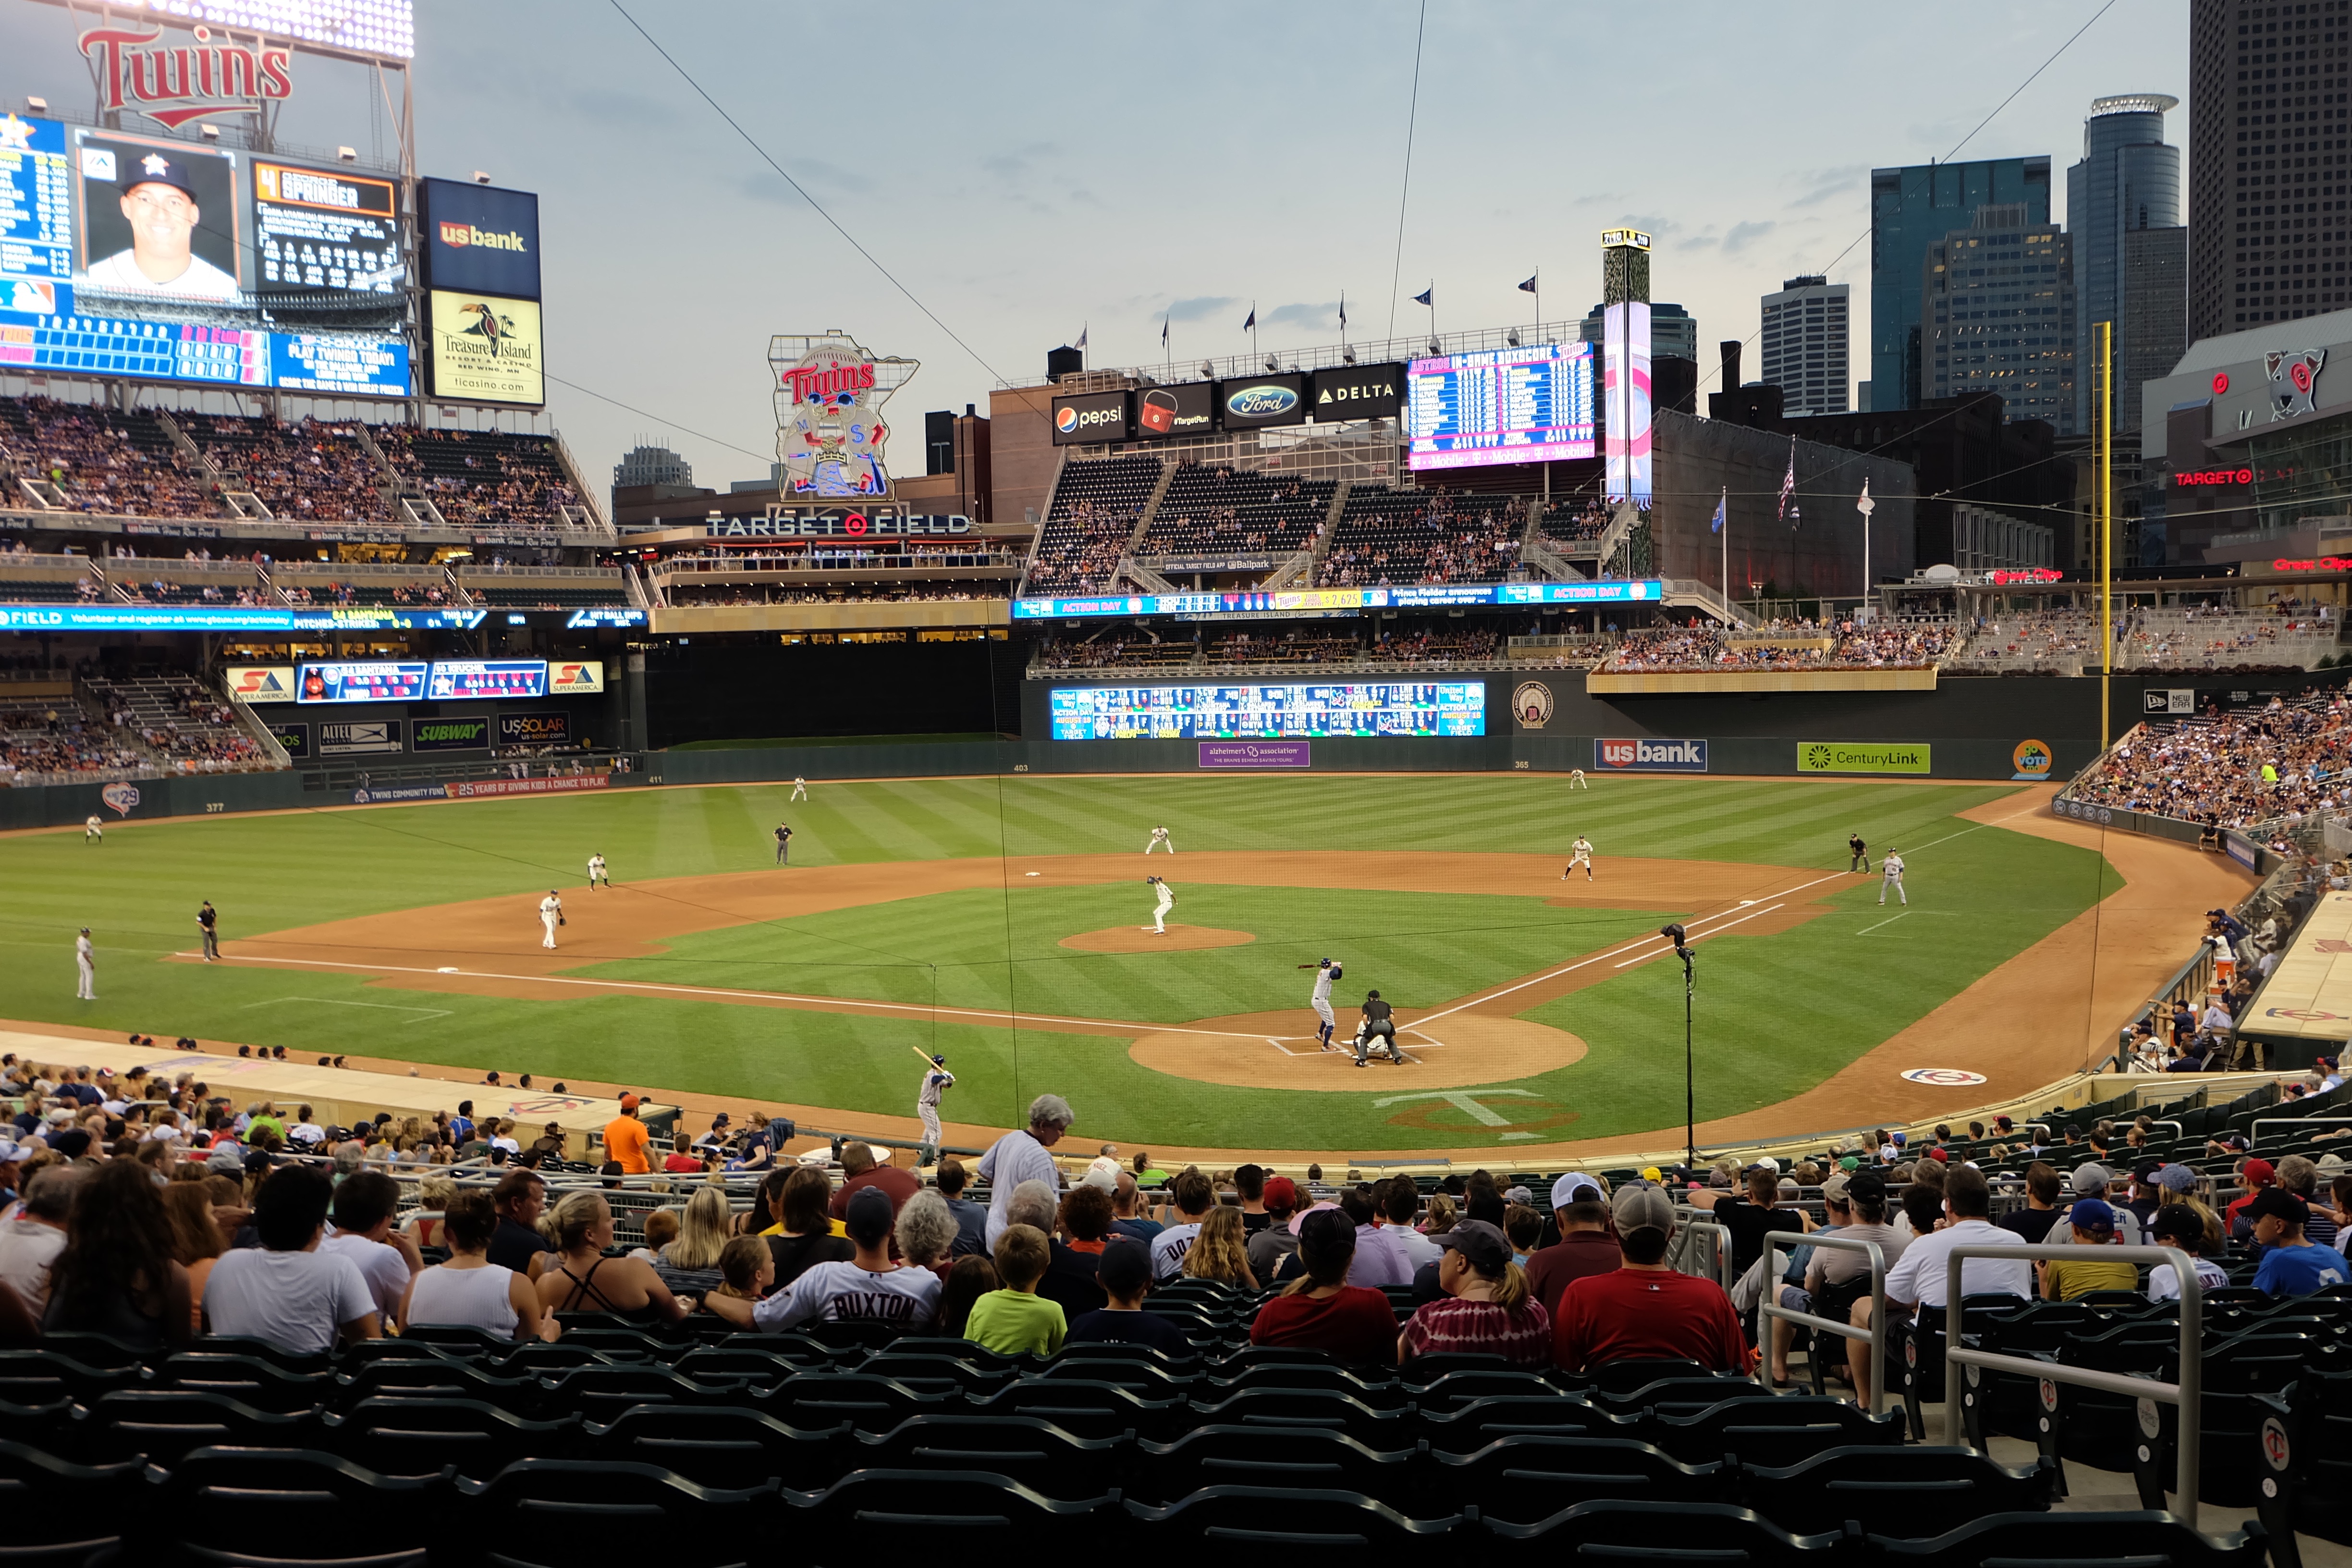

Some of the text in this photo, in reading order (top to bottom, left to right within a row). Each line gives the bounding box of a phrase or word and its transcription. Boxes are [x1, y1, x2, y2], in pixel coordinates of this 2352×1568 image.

[78, 24, 292, 113] Twins
[261, 169, 277, 196] 4
[282, 181, 358, 208] SPRINGER
[211, 328, 221, 343] E
[443, 335, 531, 359] Treasure Island
[288, 344, 395, 367] PLAY TWINGO TODAY!
[1411, 357, 1450, 372] ASTROS
[1557, 342, 1587, 359] Twins
[455, 378, 524, 392] ticasino.com
[783, 361, 874, 405] Twins
[1337, 383, 1393, 402] DELTA
[1241, 391, 1283, 413] Ford
[1080, 406, 1122, 428] pepsi
[1174, 415, 1209, 426] #TargetRun
[797, 419, 808, 431] M
[851, 425, 865, 443] S
[2176, 471, 2235, 486] TARGET
[706, 515, 969, 536] TARGET FIELD
[346, 533, 365, 542] Home
[367, 534, 381, 543] Run
[383, 535, 401, 544] Porch
[507, 537, 525, 546] Home
[527, 538, 539, 547] Run
[540, 539, 557, 547] Porch
[1237, 560, 1269, 570] Ballpark
[2273, 557, 2352, 571] Great Clips
[1994, 570, 2030, 580] Great
[2033, 569, 2063, 581] Clips
[1392, 588, 1492, 598] Prince Fielder announces
[1554, 587, 1621, 599] ACTION DAY
[1063, 601, 1121, 612] ACTION DAY
[1277, 595, 1301, 606] Twins
[1332, 594, 1358, 607] 2,625
[1398, 597, 1427, 607] playing
[11, 612, 62, 624] FIELD
[71, 613, 117, 623] Volunteer
[118, 614, 135, 623] and
[135, 614, 172, 625] register
[347, 611, 395, 620] SANTANA
[442, 611, 473, 620] THIS AB
[509, 616, 526, 624] MPH
[590, 612, 642, 620] HIT BALL INFO
[1063, 700, 1075, 709] Way
[1515, 685, 1551, 719] ANNIVERSARY WORLD CHAMPIONS
[322, 725, 351, 738] ALTEC
[417, 723, 485, 741] SUBWAY
[521, 732, 565, 740] us-solar.com
[2024, 746, 2038, 756] go
[1837, 751, 1919, 765] CenturyLink
[2018, 756, 2047, 765] VOTE
[372, 787, 444, 799] TWINS COMMUNITY FUND
[459, 777, 606, 796] 25 YEARS OF GIVING KIDS A CHANCE TO PLAY.
[121, 790, 137, 804] 29
[207, 803, 224, 812] 377
[1166, 1236, 1195, 1262] DOZ
[834, 1293, 916, 1321] BUXTON
